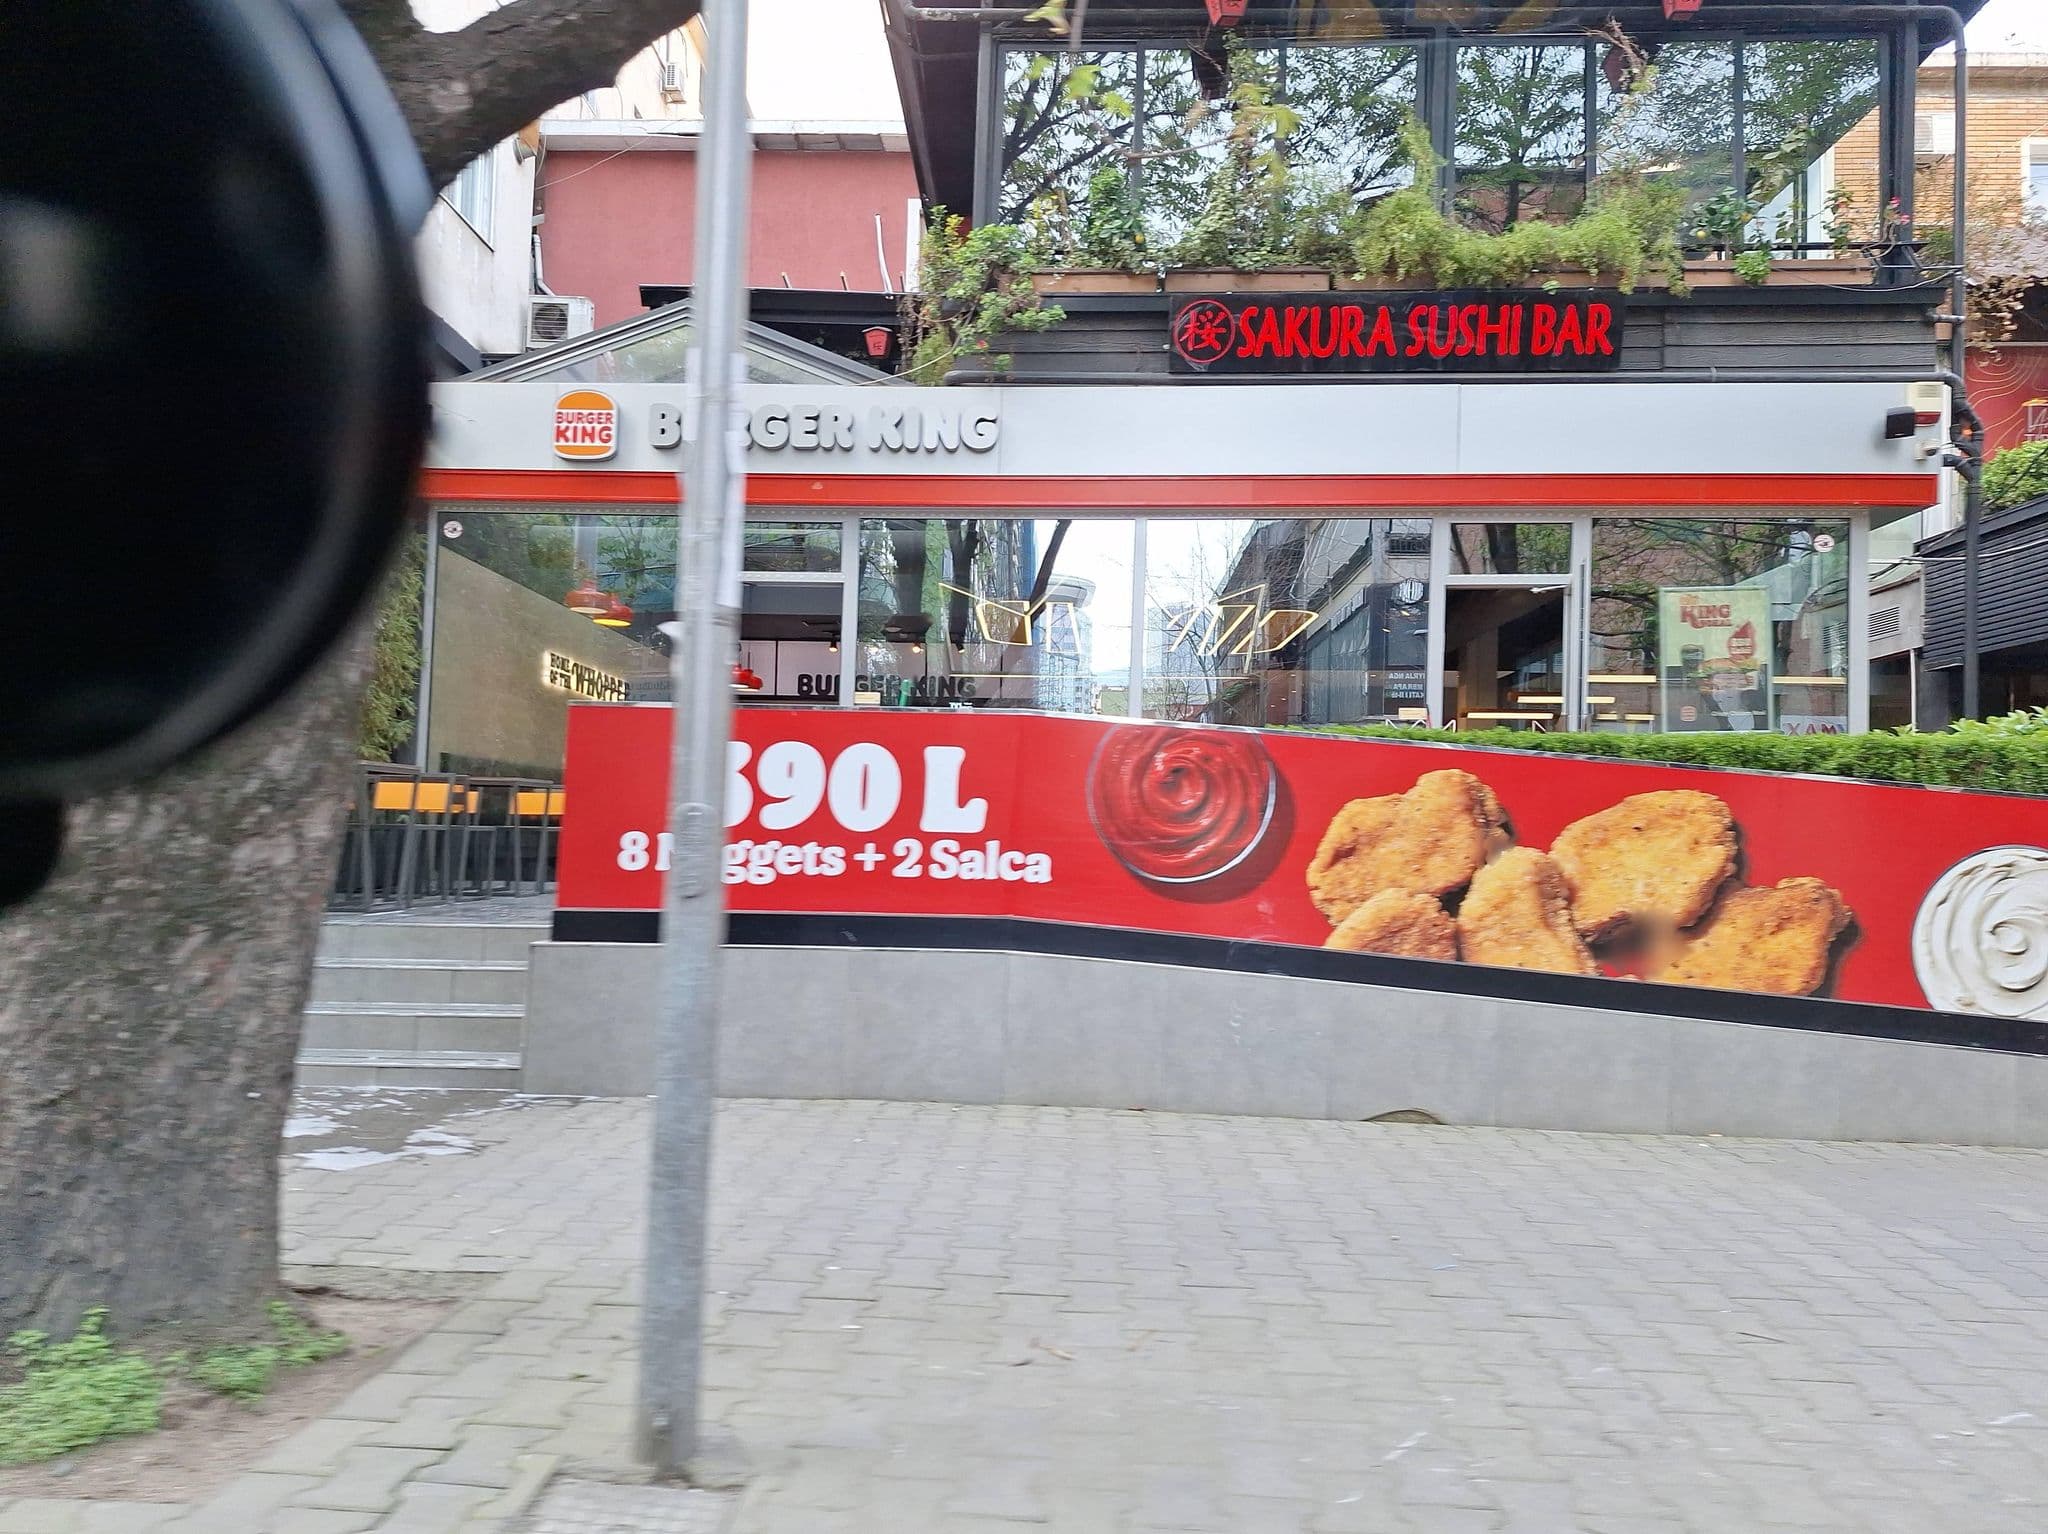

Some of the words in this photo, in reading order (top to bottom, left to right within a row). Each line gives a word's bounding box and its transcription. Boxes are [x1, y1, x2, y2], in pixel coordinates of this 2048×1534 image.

[1179, 310, 1228, 352] 桜
[1236, 304, 1398, 359] SAKURA
[1404, 303, 1524, 358] SUSHI
[1530, 303, 1615, 357] BAR
[555, 411, 614, 425] BURGER
[555, 425, 613, 444] KING
[649, 402, 855, 451] BGER
[867, 404, 999, 453] KING
[910, 675, 977, 699] KING
[919, 745, 989, 833] L
[616, 830, 650, 871] 8
[654, 832, 847, 885] ggets
[853, 842, 887, 872] +
[891, 838, 923, 878] 2
[928, 839, 1053, 884] Salca
